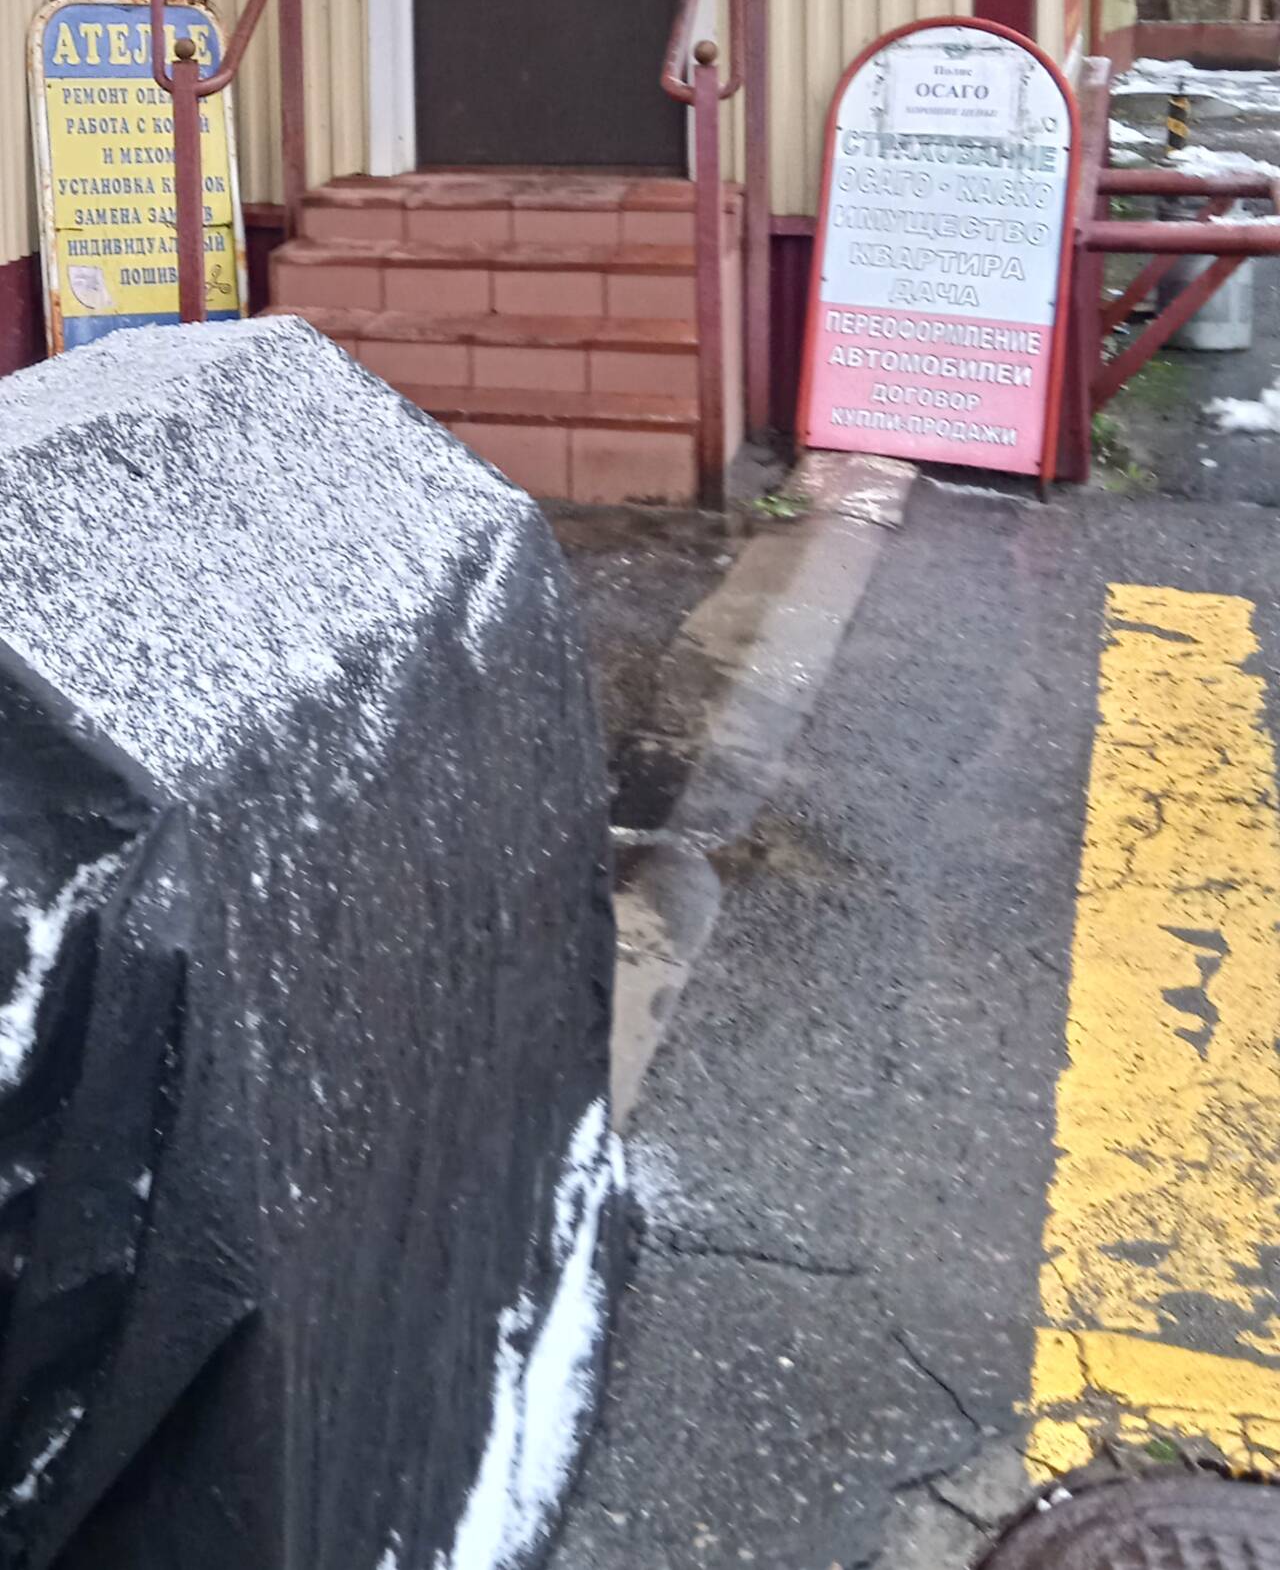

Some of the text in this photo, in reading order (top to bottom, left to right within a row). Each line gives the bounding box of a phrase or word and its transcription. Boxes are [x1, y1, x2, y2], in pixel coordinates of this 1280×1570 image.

[63, 87, 128, 105] РЕМОНТ
[915, 82, 990, 100] ОСАГО
[66, 117, 130, 134] РАБОТА
[137, 117, 146, 134] С
[58, 177, 156, 196] УСТАНОВКА
[838, 165, 1054, 209] ОСАГО КАСКО
[75, 207, 141, 225] ЗАМЕНА
[834, 204, 1050, 246] ИМУЩЕСТВО
[849, 242, 1025, 281] КВАРТИРА
[120, 267, 178, 285] ПОШИВ
[888, 278, 980, 306] ДАЧА
[825, 309, 1041, 356] ПЕРЕОФОРМЛЕНИЕ
[872, 382, 982, 411] ДОГОВОР
[830, 406, 1018, 446] КУПЛИ-ПРОДАЖИ
